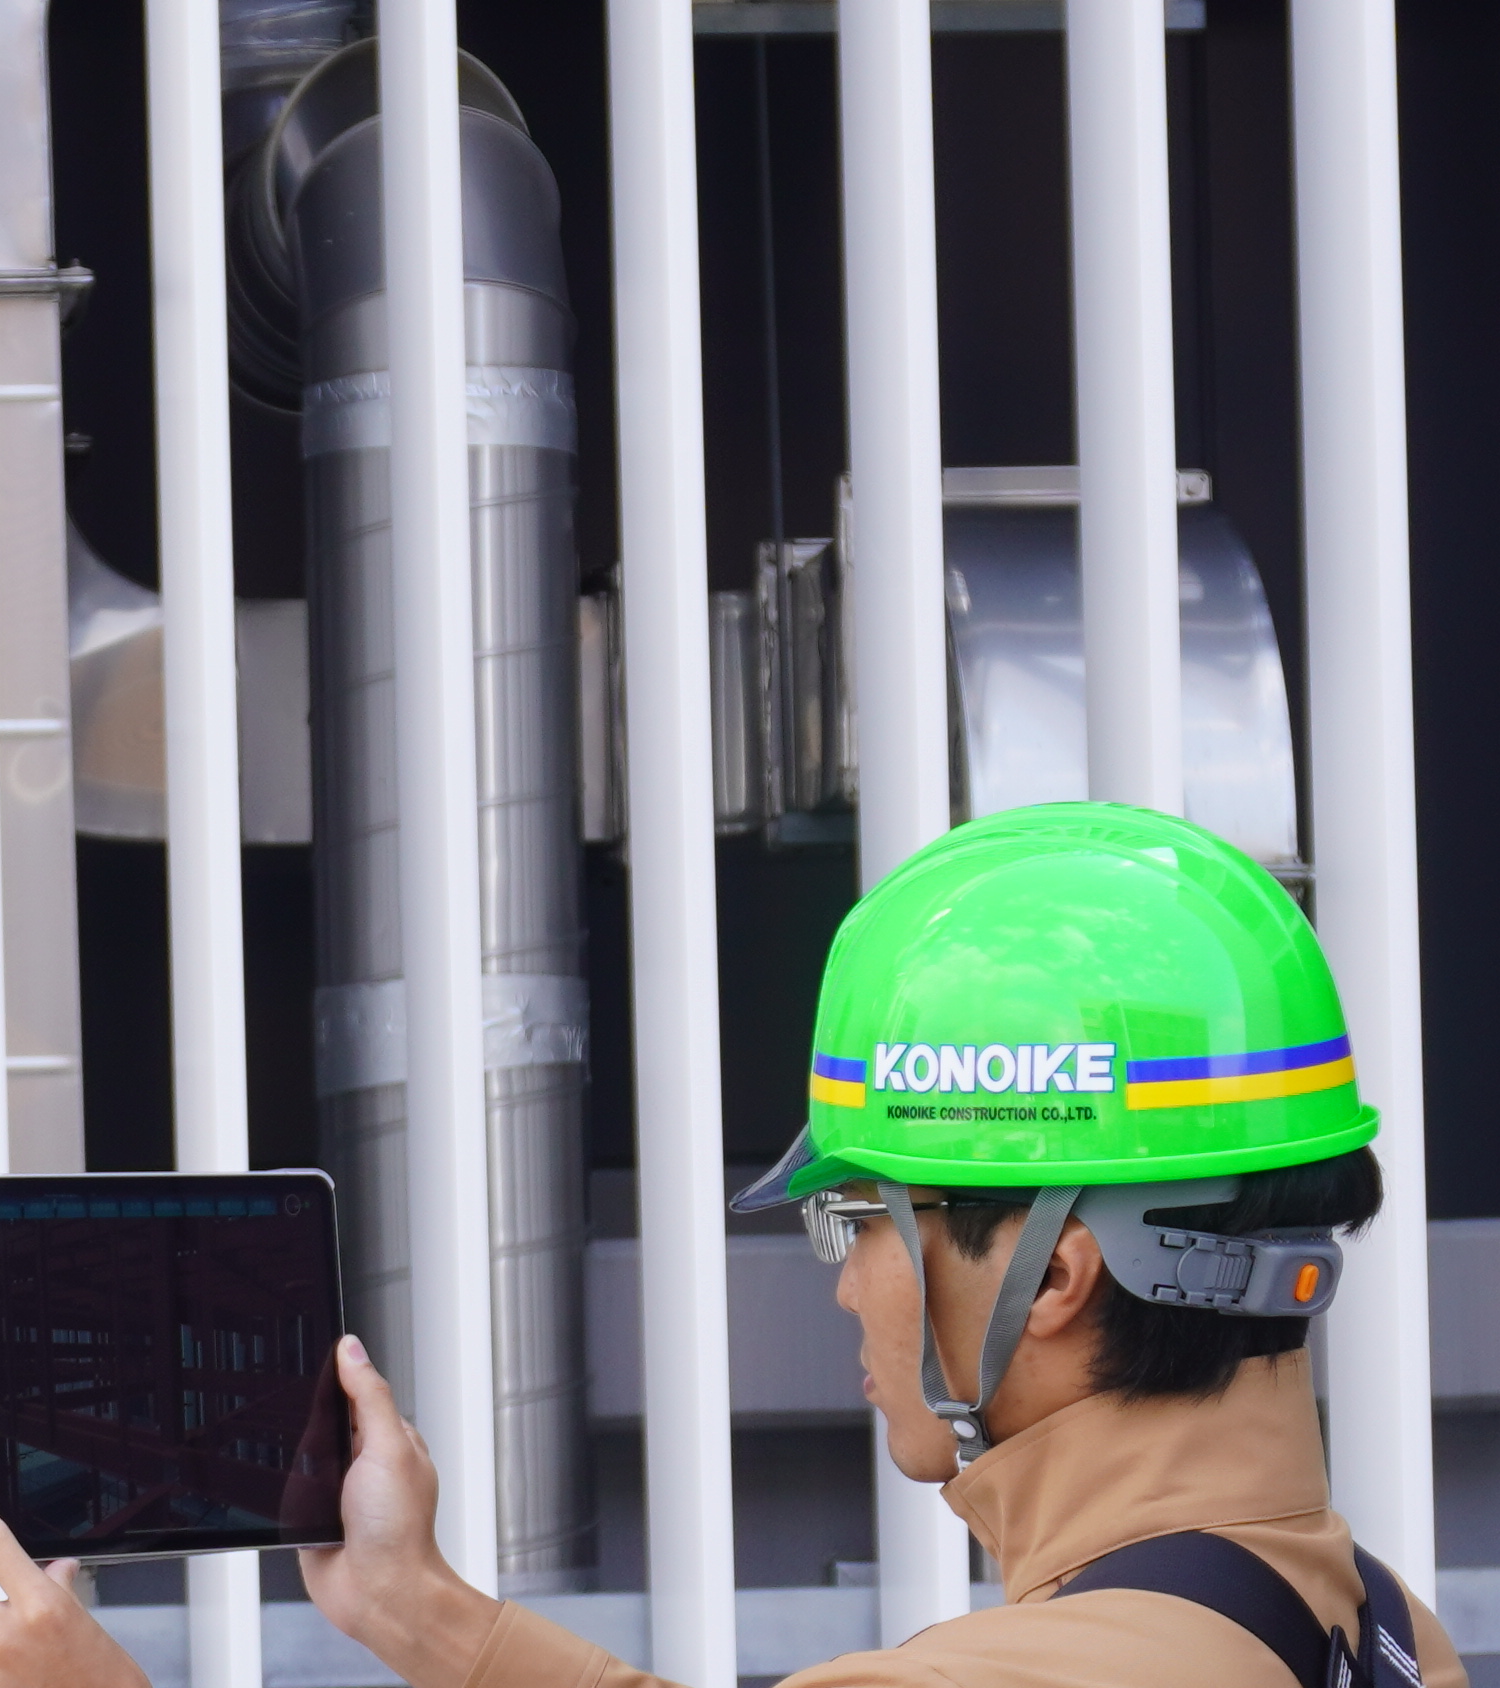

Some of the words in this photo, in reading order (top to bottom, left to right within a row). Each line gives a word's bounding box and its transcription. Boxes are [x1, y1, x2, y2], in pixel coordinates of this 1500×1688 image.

[874, 1042, 1117, 1094] KONOIKE
[886, 1105, 936, 1121] KONOIKE
[939, 1106, 1037, 1122] CONSTRUCTION
[1041, 1106, 1098, 1124] CO.,LTD.
